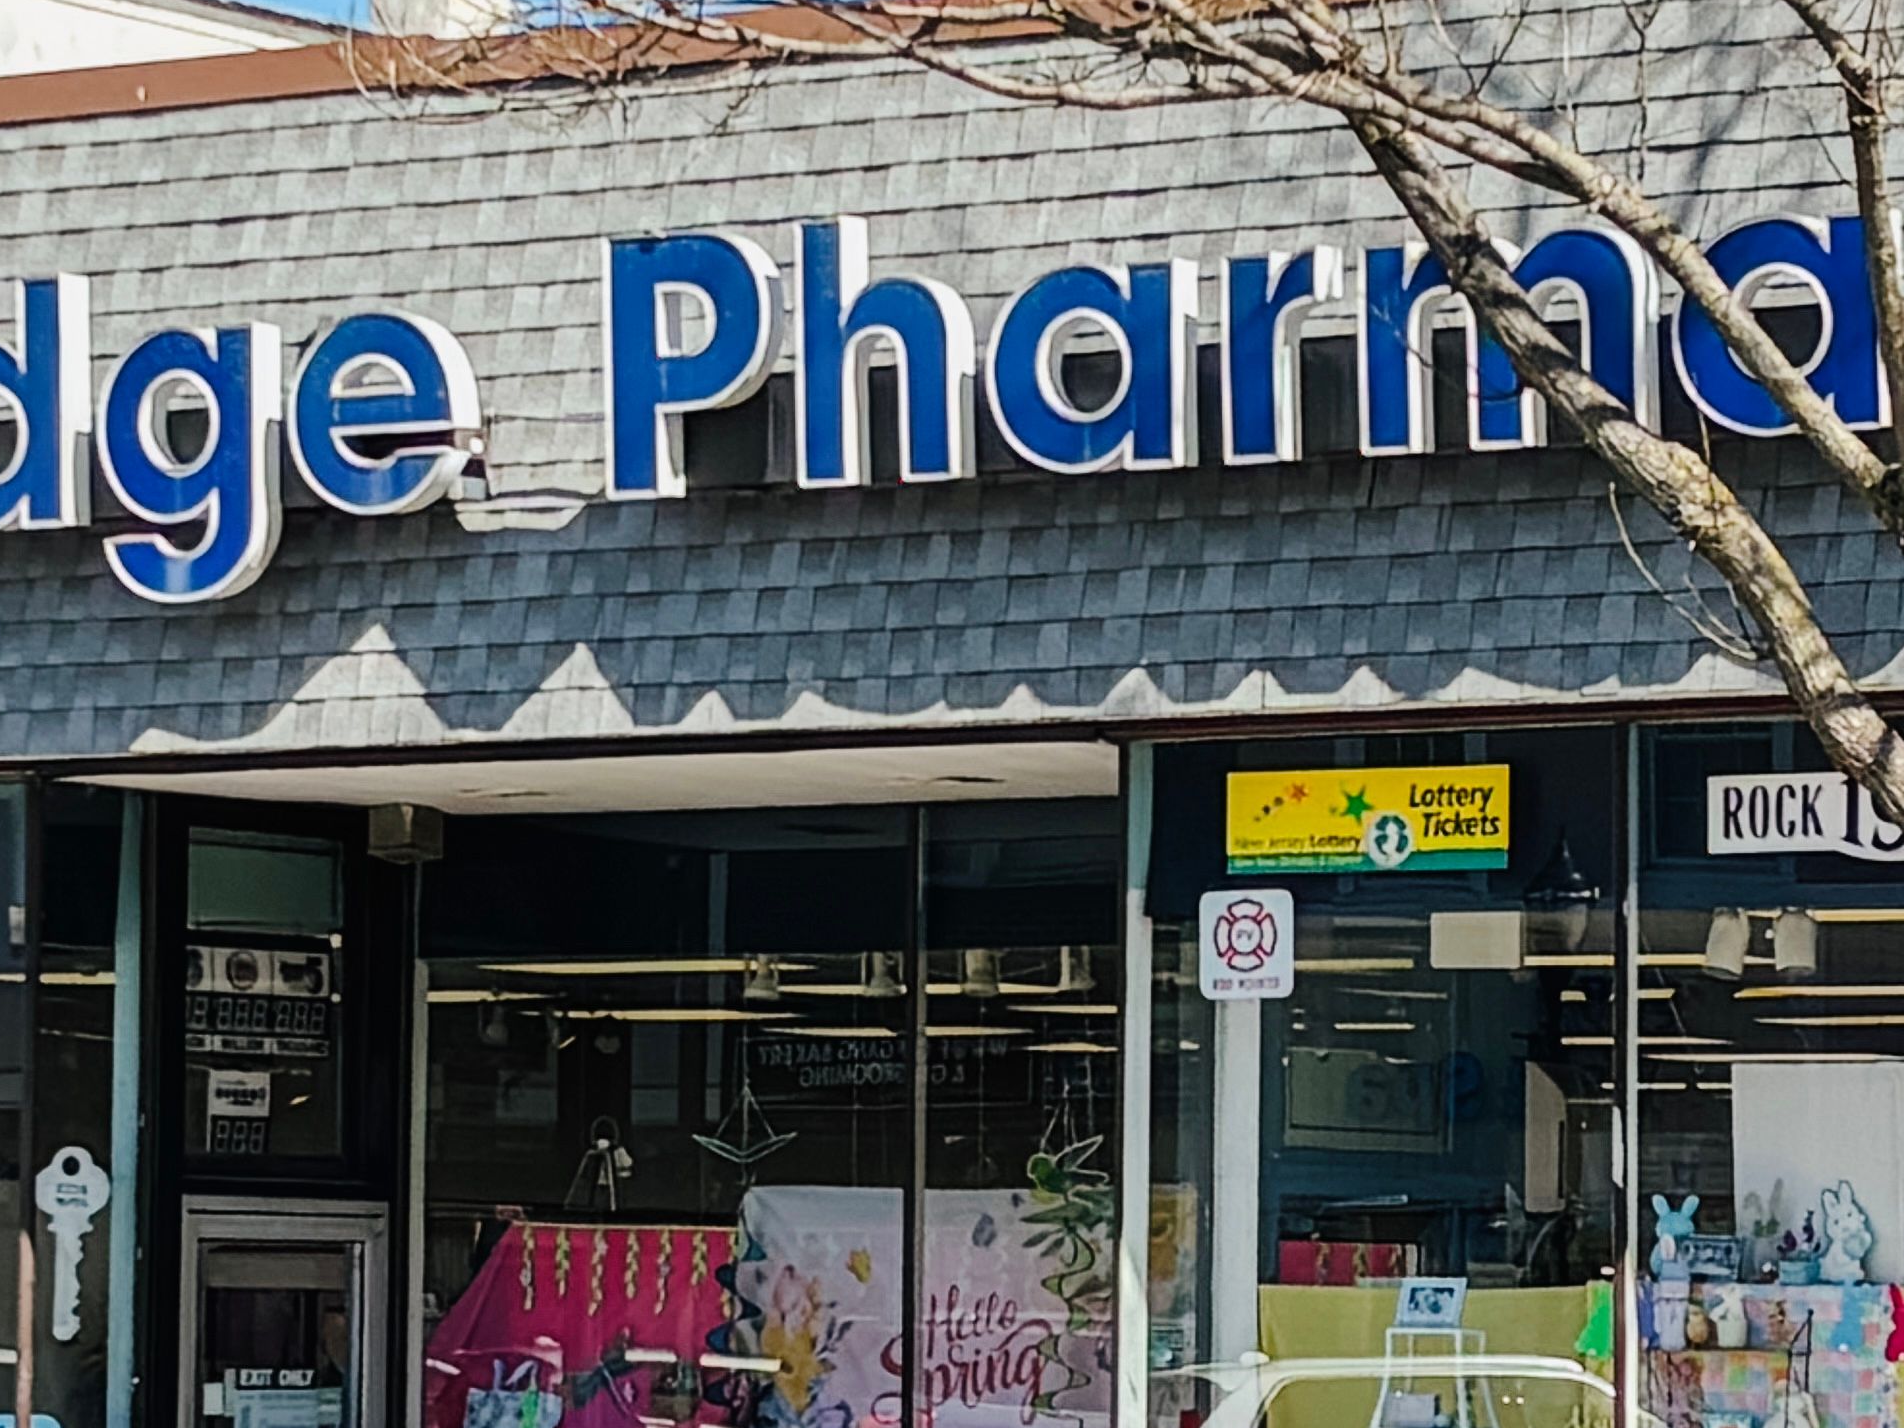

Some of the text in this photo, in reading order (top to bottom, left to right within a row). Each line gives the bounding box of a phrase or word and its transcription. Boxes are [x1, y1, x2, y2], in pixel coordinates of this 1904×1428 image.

[1409, 784, 1494, 812] Lottery
[1422, 812, 1501, 838] Tickets
[1722, 784, 1824, 840] ROCK
[1309, 834, 1361, 851] Lottery
[924, 1284, 1018, 1360] Hello
[239, 1368, 315, 1387] EXIT ONLY
